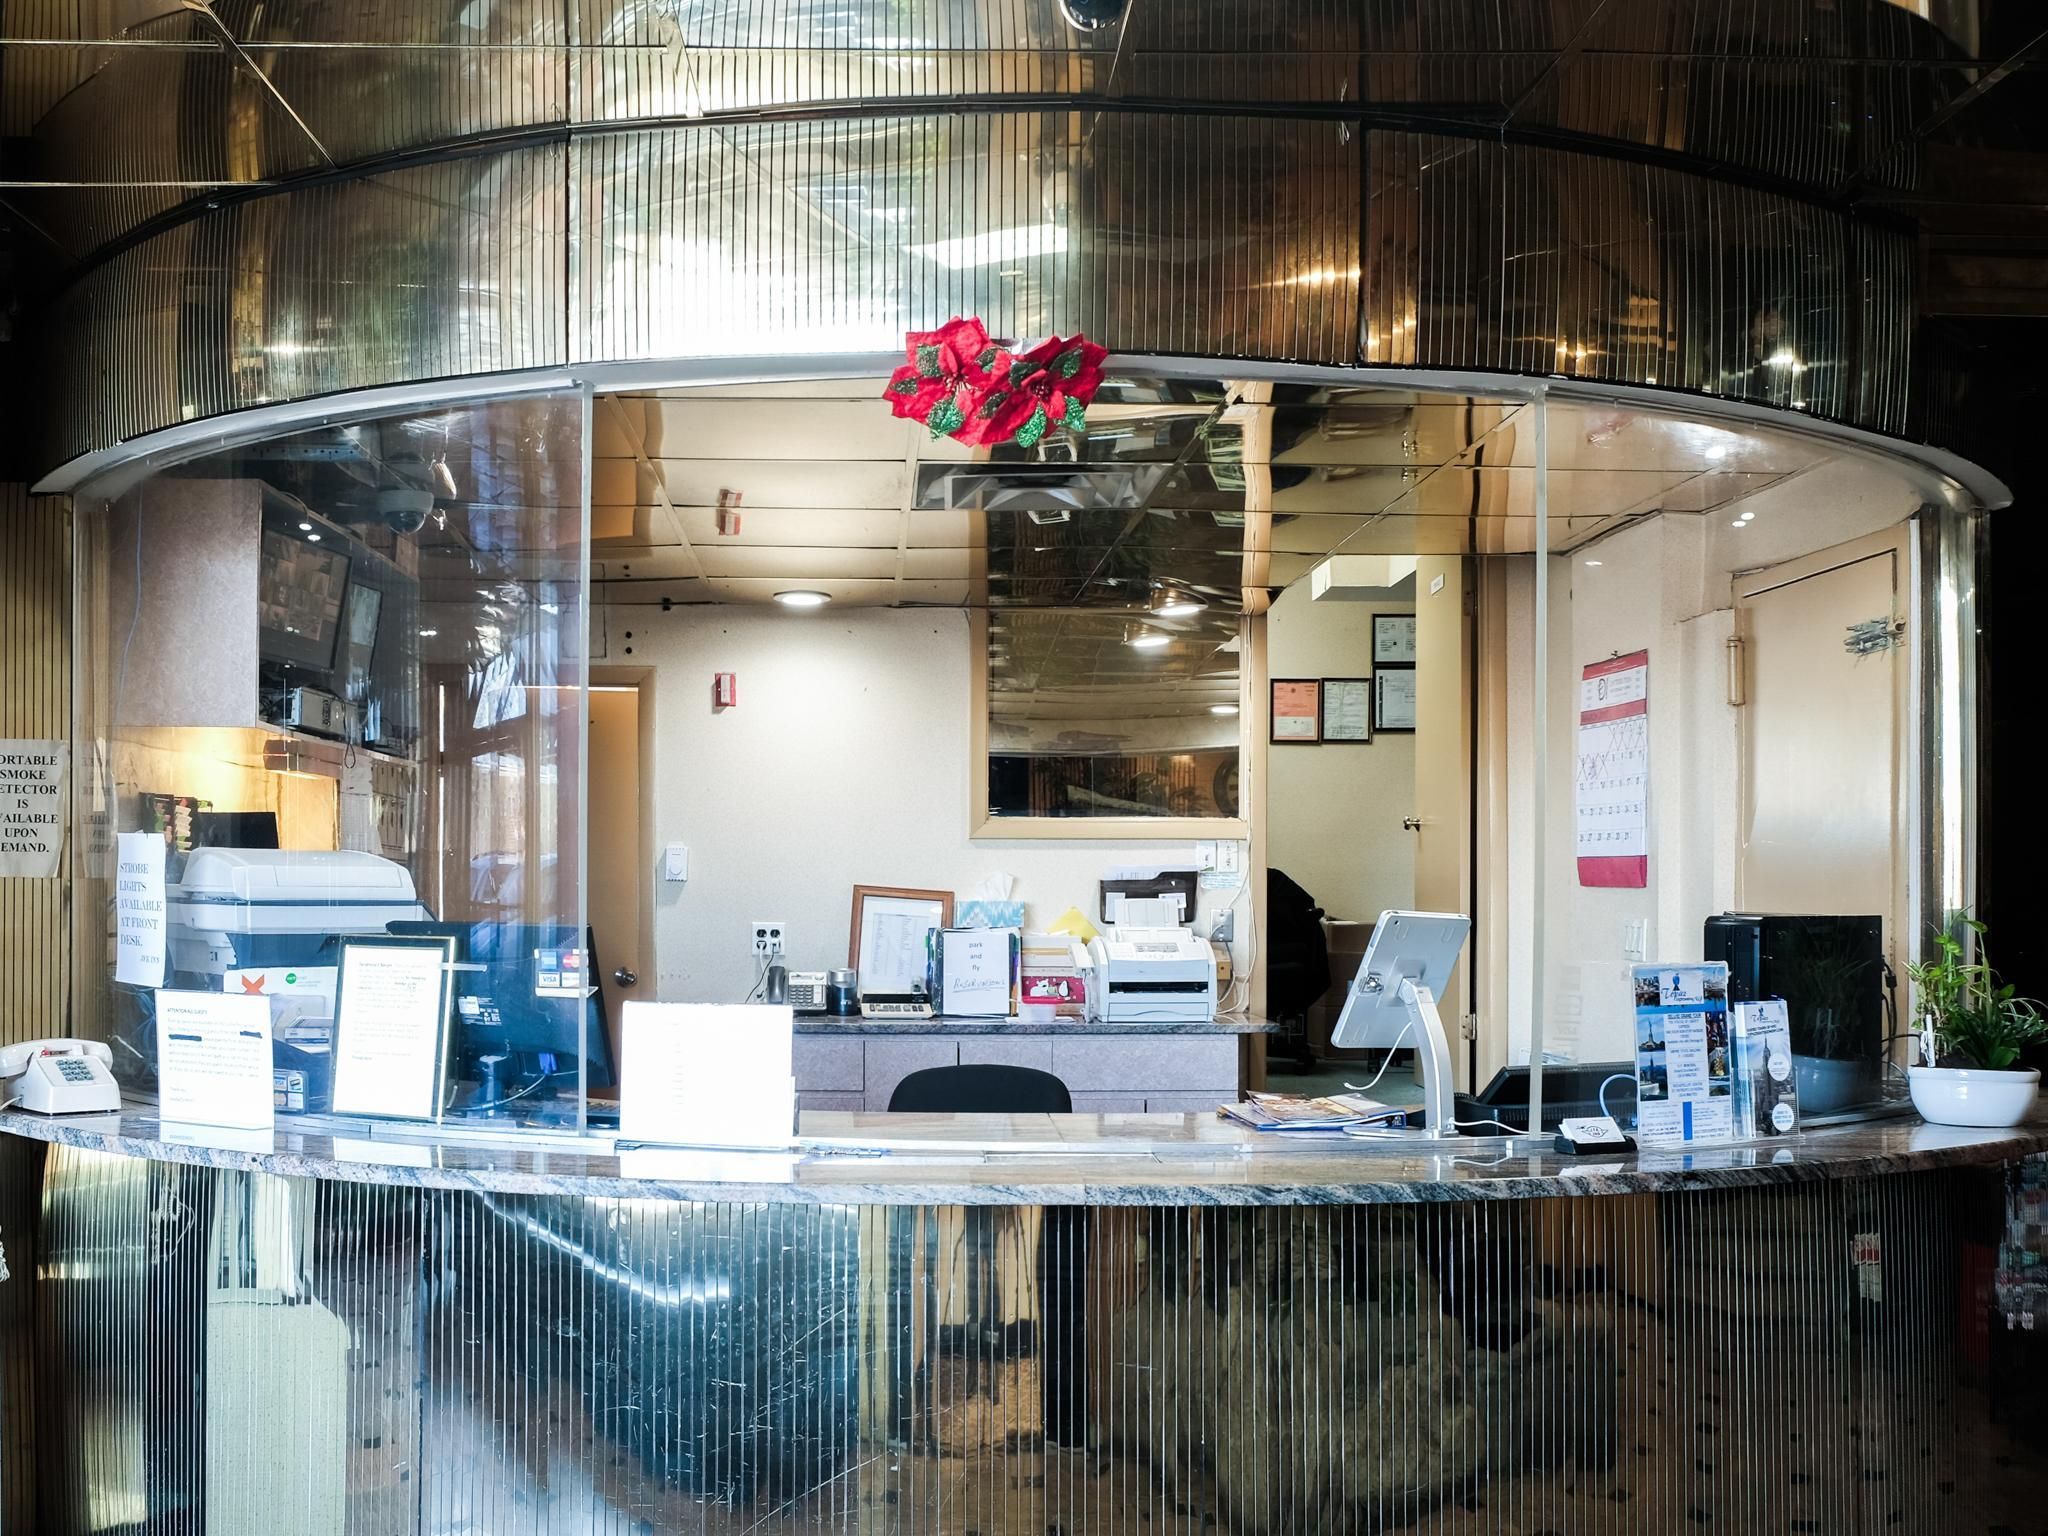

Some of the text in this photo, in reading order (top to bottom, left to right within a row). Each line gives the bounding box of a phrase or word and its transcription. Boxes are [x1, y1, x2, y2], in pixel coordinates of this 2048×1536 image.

[0, 755, 57, 765] ORTABLE
[0, 769, 46, 779] SMOKE
[0, 784, 57, 794] ETECTOR
[17, 799, 29, 808] IS
[0, 813, 59, 824] AILABLE
[5, 828, 38, 837] UPON
[1, 842, 50, 852] EMAND.
[120, 863, 149, 873] STROBE
[120, 880, 147, 891] LIGHTS
[120, 899, 162, 911] AVAILABLE
[120, 917, 159, 930] AT FRONT
[120, 934, 143, 946] DESK.
